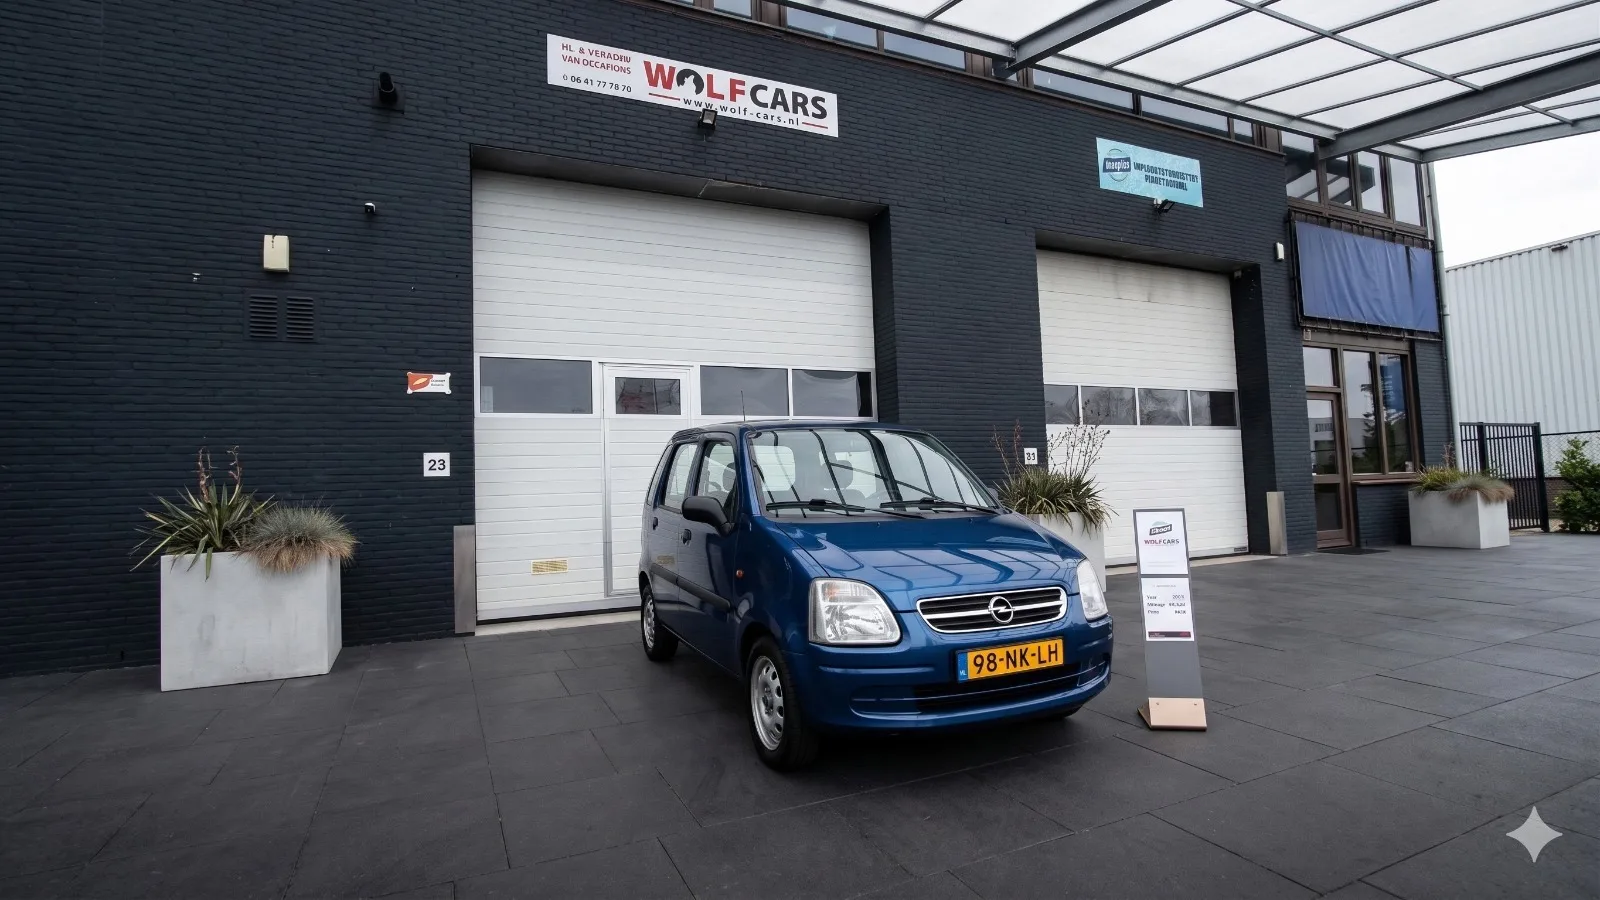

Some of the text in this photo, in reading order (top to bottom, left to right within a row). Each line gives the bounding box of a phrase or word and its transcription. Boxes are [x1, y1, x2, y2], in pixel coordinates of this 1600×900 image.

[562, 54, 580, 64] VAN
[571, 75, 631, 93] 06 41 77 78 70
[683, 98, 799, 126] www.wolf-cars.nl
[428, 459, 446, 471] 23
[973, 643, 1058, 675] 98-NK-LH
